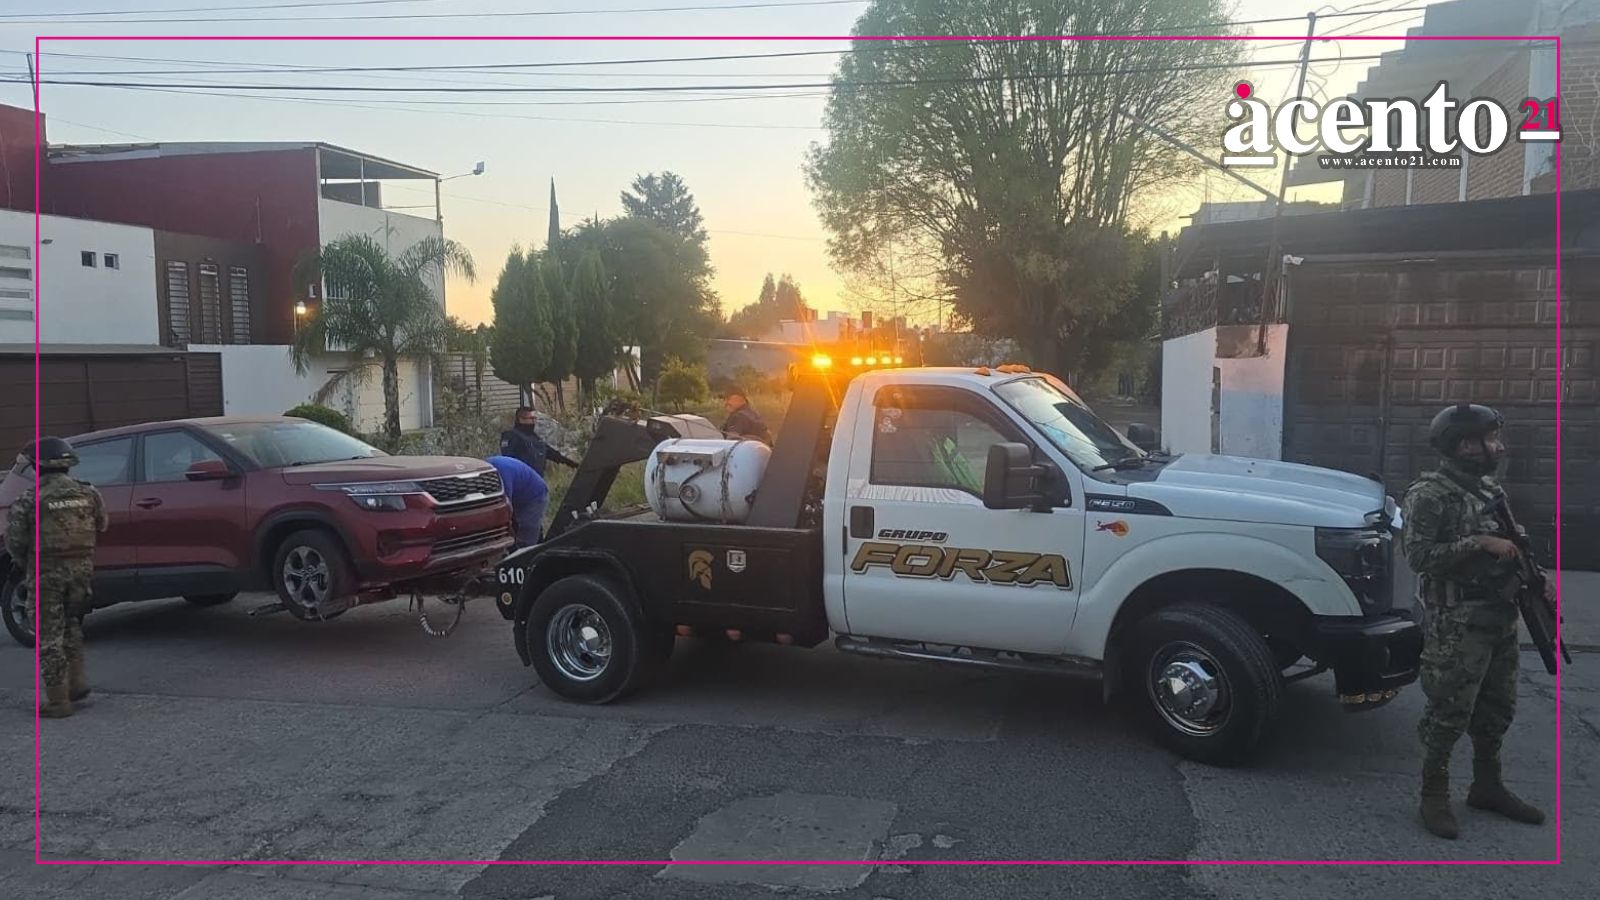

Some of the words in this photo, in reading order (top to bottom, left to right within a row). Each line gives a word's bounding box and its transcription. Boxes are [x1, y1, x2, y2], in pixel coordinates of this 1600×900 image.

[877, 528, 949, 542] GRUPO
[850, 541, 1073, 589] FORZA
[498, 567, 525, 585] 610
